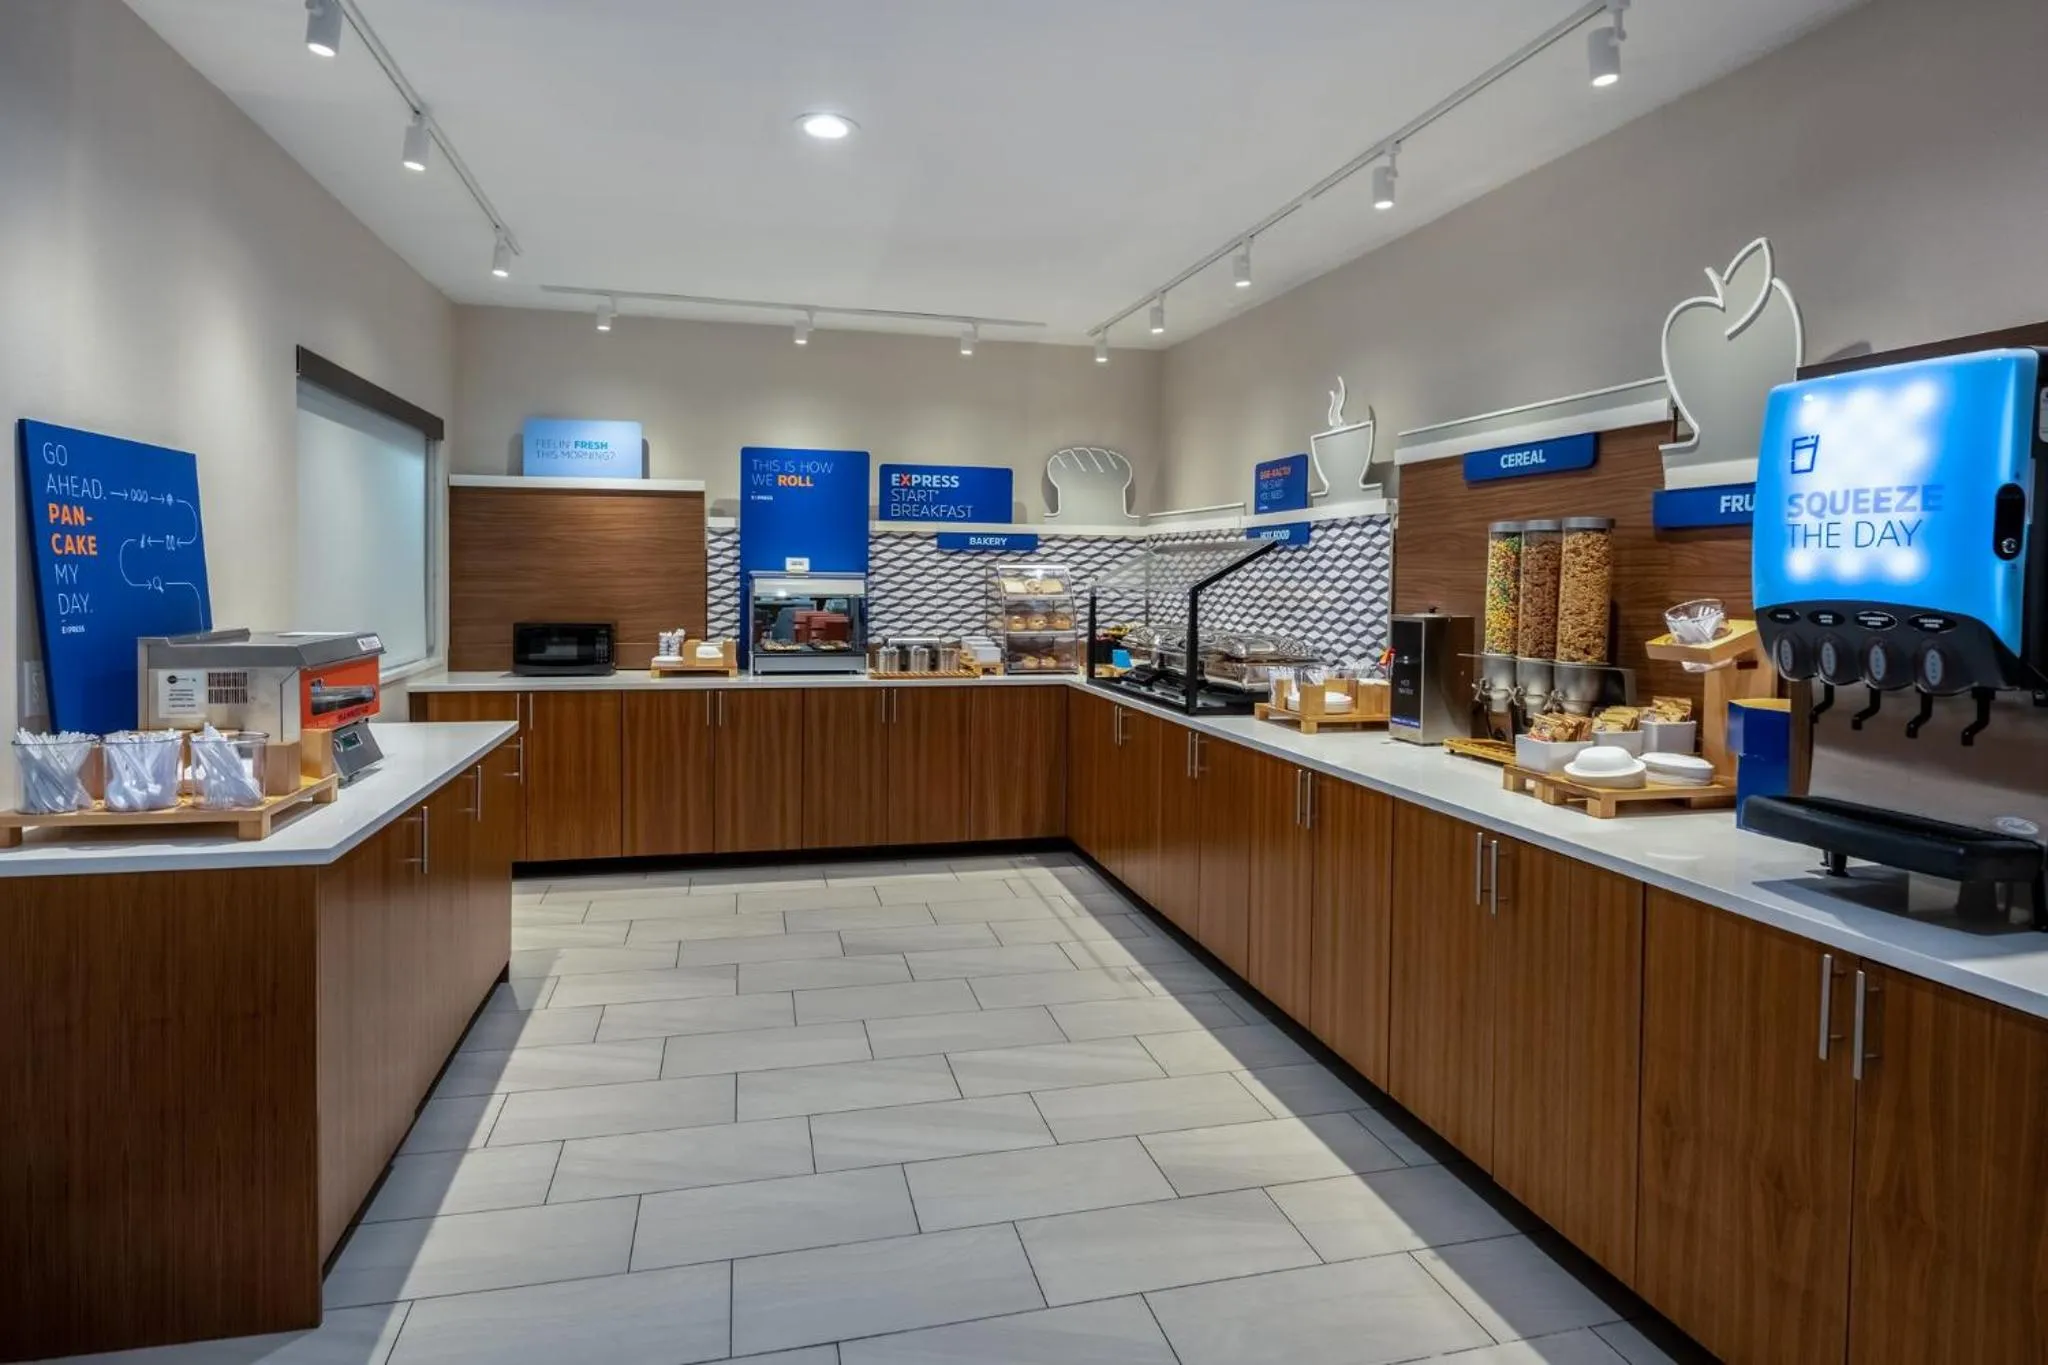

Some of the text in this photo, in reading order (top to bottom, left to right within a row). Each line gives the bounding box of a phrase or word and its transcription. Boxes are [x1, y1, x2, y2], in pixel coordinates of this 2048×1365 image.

[43, 441, 68, 467] GO
[574, 440, 609, 450] FRESH
[752, 459, 834, 474] THIS IS HOW
[1500, 449, 1546, 469] CEREAL
[46, 473, 107, 500] AHEAD.
[752, 474, 814, 487] WE ROLL
[891, 473, 960, 488] EXPRESS
[891, 503, 973, 518] BREAKFAST
[1787, 484, 1945, 519] SQUEEZE
[48, 503, 93, 526] PAN-
[51, 533, 98, 556] CAKE
[969, 537, 1007, 546] BAKERY
[1260, 529, 1290, 540] HOT FOOD
[1786, 519, 1922, 549] THE DAY
[55, 563, 79, 585] MY
[58, 593, 94, 615] DAY.
